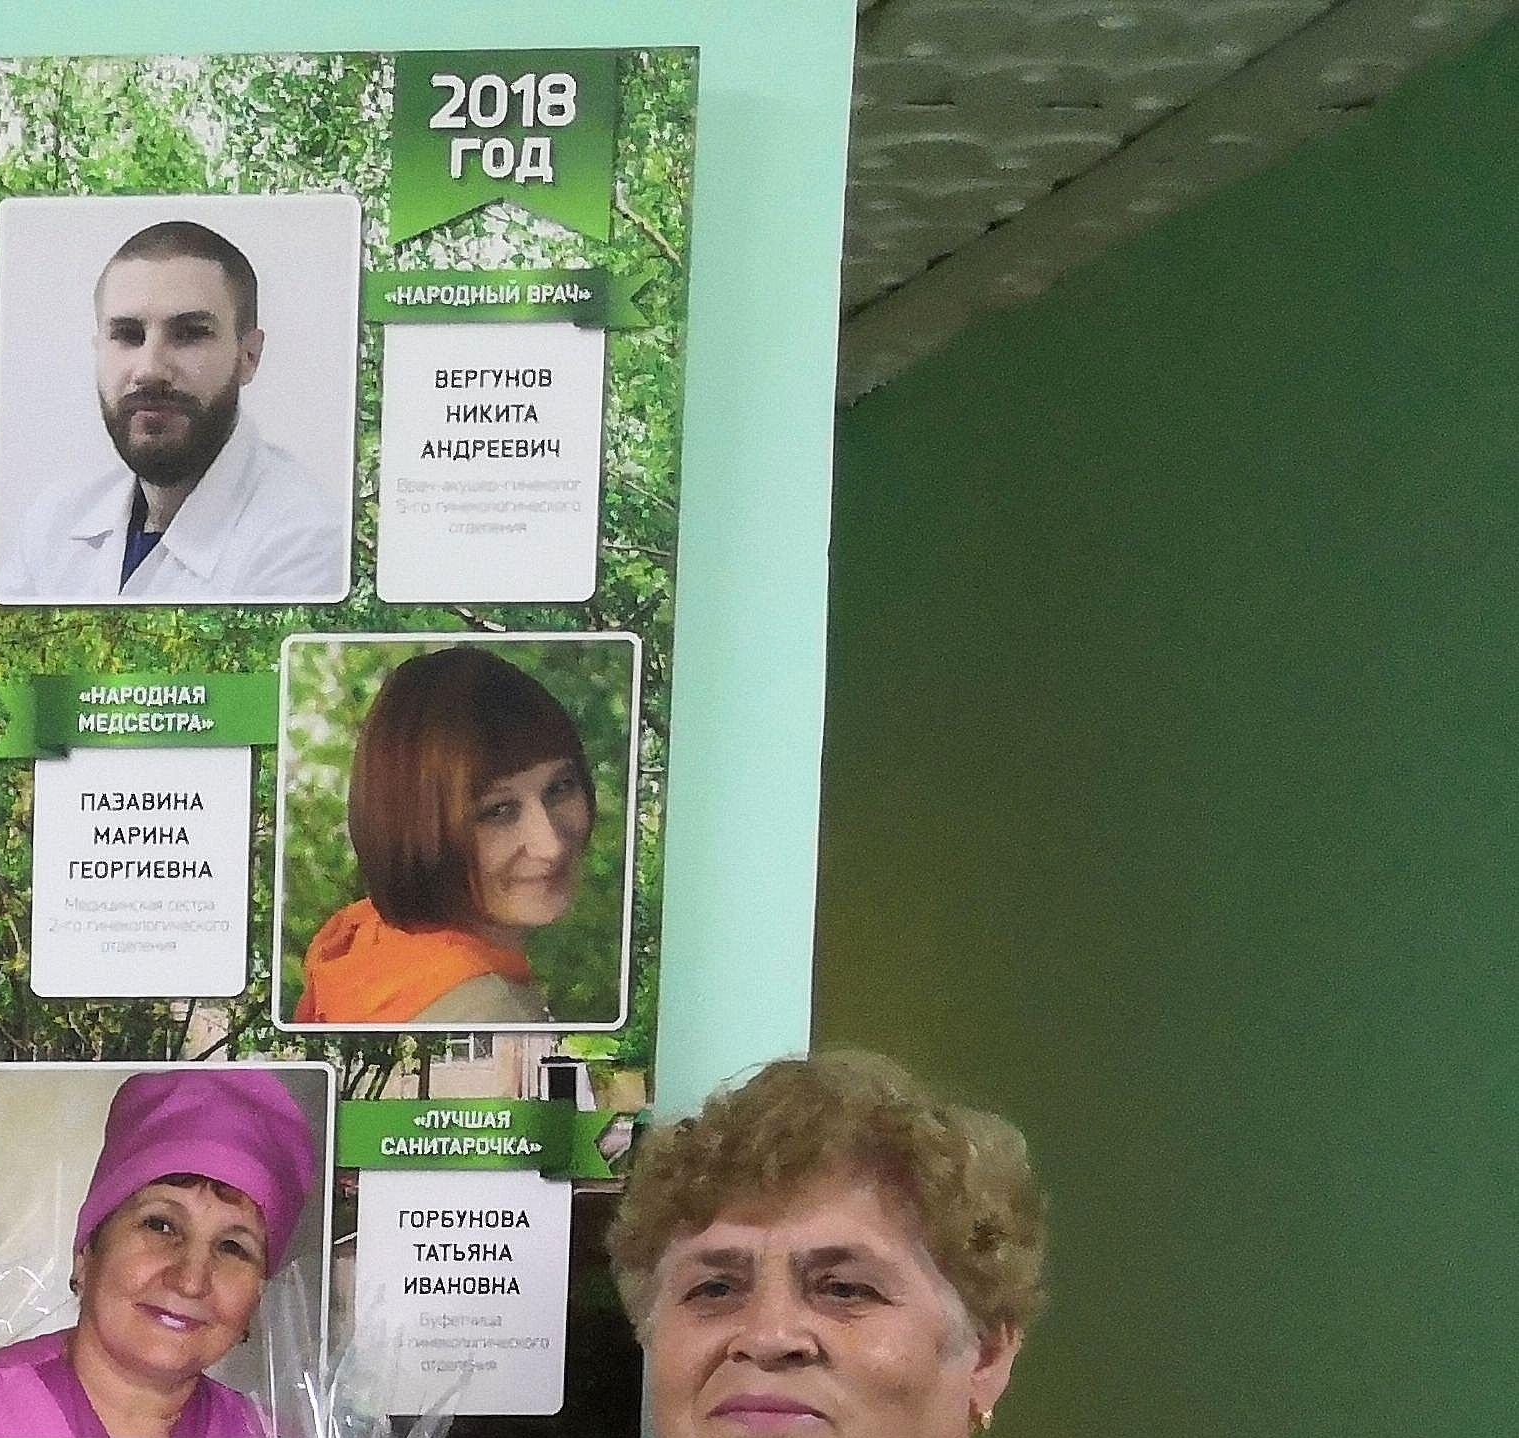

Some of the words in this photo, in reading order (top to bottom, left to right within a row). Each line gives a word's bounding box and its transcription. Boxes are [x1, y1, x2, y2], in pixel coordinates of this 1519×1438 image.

[429, 72, 577, 130] 2018
[451, 136, 554, 184] ГОД
[385, 279, 520, 307] «НАРОДНЫЙ
[527, 284, 593, 304] ВРАЧ»
[435, 368, 553, 390] ВЕРГУНОВ
[445, 404, 539, 424] НИКИТА
[421, 438, 561, 460] АНДРЕЕВИЧ
[79, 685, 206, 706] «НАРОДНАЯ
[78, 713, 214, 734] МЕДСЕСТРА»
[80, 793, 204, 812] ПАЗАВИНА
[93, 826, 190, 846] МАРИНА
[68, 860, 213, 880] ГЕОРГИЕВНА
[414, 1110, 511, 1129] «ЛУЧШАЯ
[381, 1136, 543, 1157] САНИТАРОЧКА»
[399, 1210, 531, 1230] ГОРБУНОВА
[413, 1243, 513, 1263] ТАТЬЯНА
[404, 1276, 521, 1297] ИВАНОВНА
